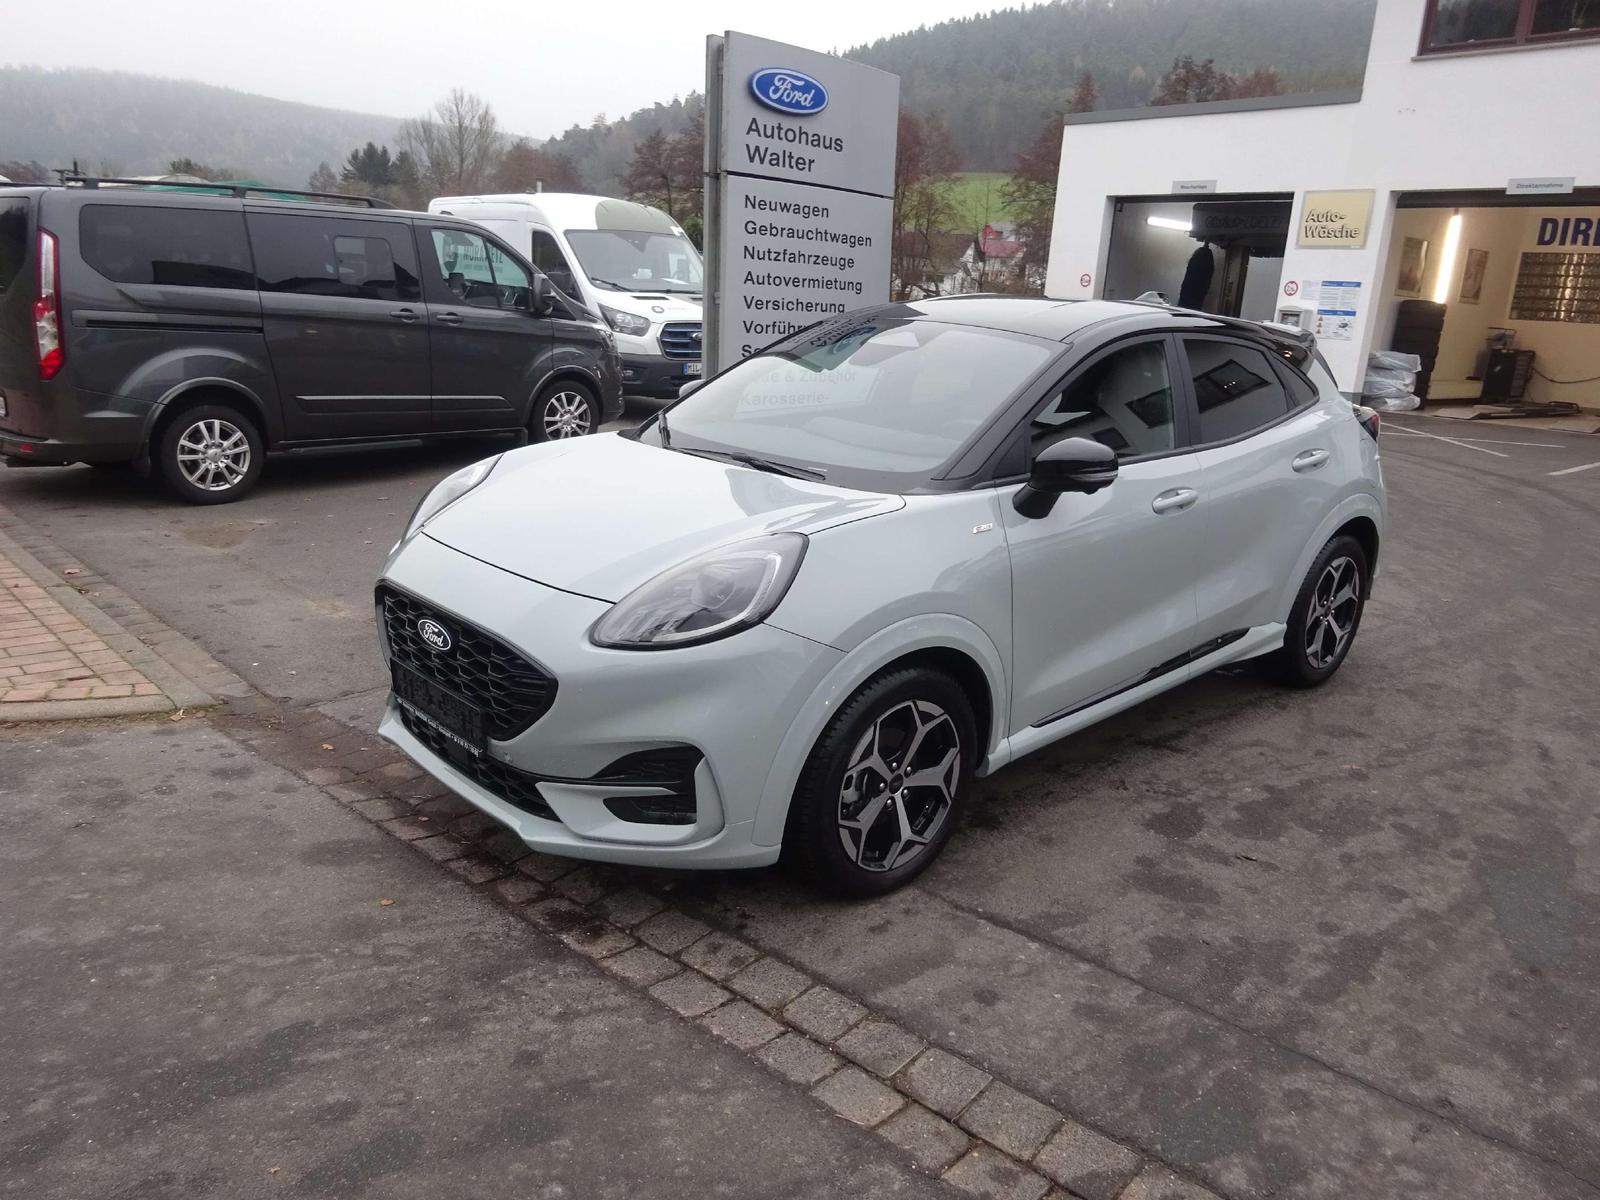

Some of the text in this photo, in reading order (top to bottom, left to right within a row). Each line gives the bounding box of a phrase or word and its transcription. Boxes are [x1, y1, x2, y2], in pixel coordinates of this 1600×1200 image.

[768, 74, 816, 107] Ford
[745, 117, 844, 152] Autohaus
[745, 143, 816, 172] Walter
[744, 195, 830, 219] Neuwagen
[1305, 209, 1347, 223] Auto-
[744, 220, 872, 248] Gebrauchtwagen
[1304, 224, 1360, 239] Wäsche
[743, 246, 855, 270] Nutzfahrzeuge
[743, 271, 863, 295] Autovermietung
[423, 622, 444, 647] Ford
